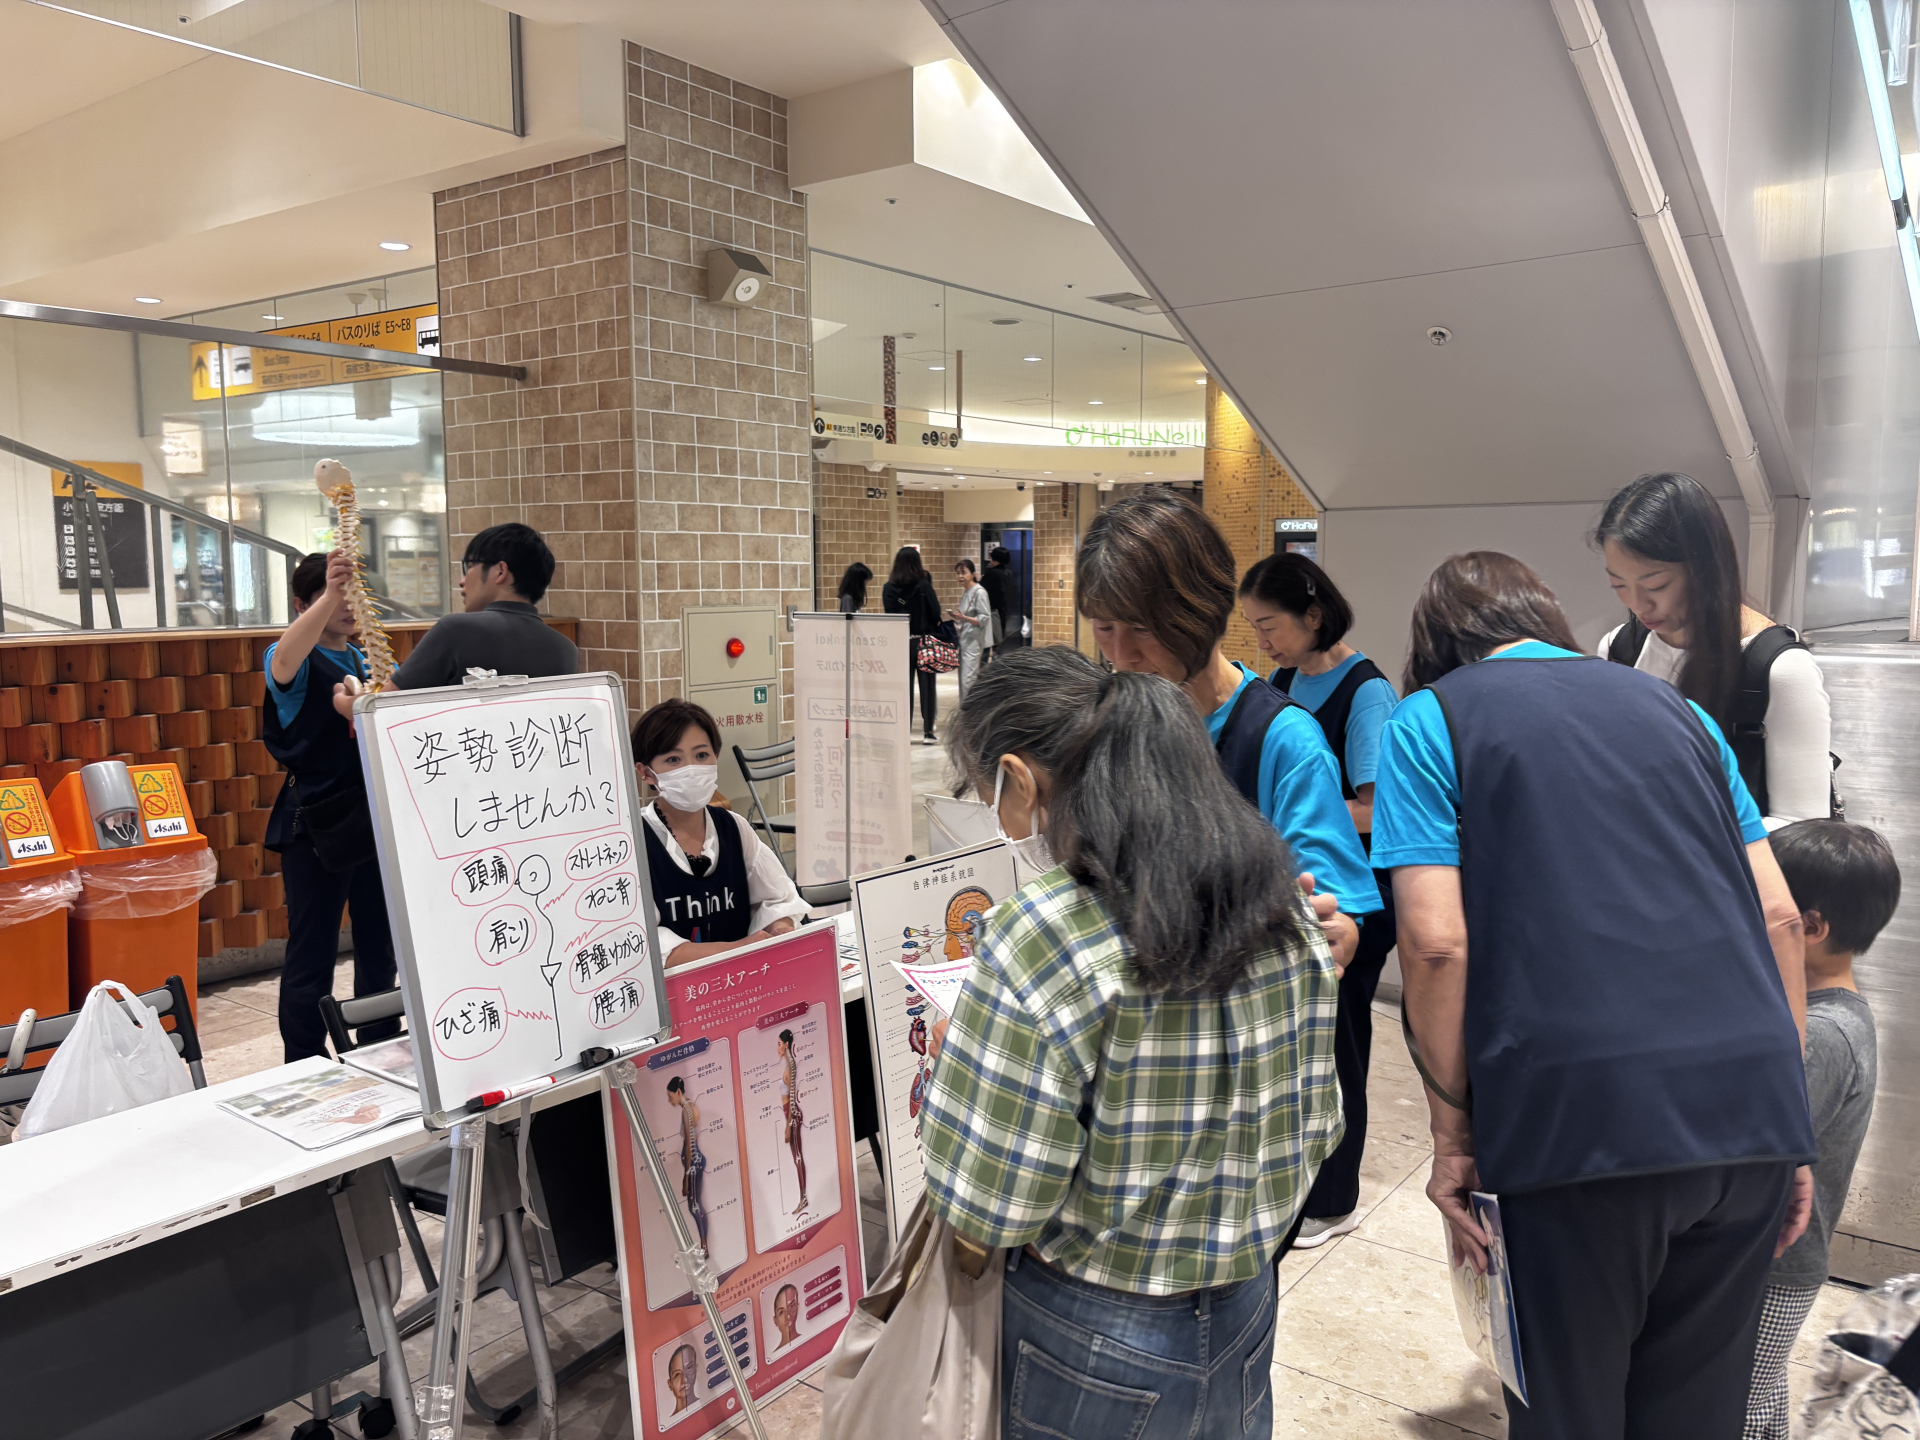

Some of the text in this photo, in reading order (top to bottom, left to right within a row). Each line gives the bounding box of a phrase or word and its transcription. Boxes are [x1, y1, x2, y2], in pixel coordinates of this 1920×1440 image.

[337, 321, 381, 341] バスのりば
[414, 713, 593, 785] 姿勢診断
[154, 821, 182, 834] Asahi
[455, 781, 615, 839] しませんか?
[18, 840, 47, 854] Asahi
[568, 840, 628, 872] ストレートネック
[462, 855, 509, 893] 頭痛
[585, 876, 631, 909] ねこ背
[664, 886, 735, 922] Think
[489, 917, 530, 955] 肩こり
[575, 930, 645, 983] 骨盤ゆがみ
[684, 962, 771, 1003] 美の三大アーチ
[435, 1001, 501, 1040] ひざ痛
[593, 980, 640, 1024] 腰痛
